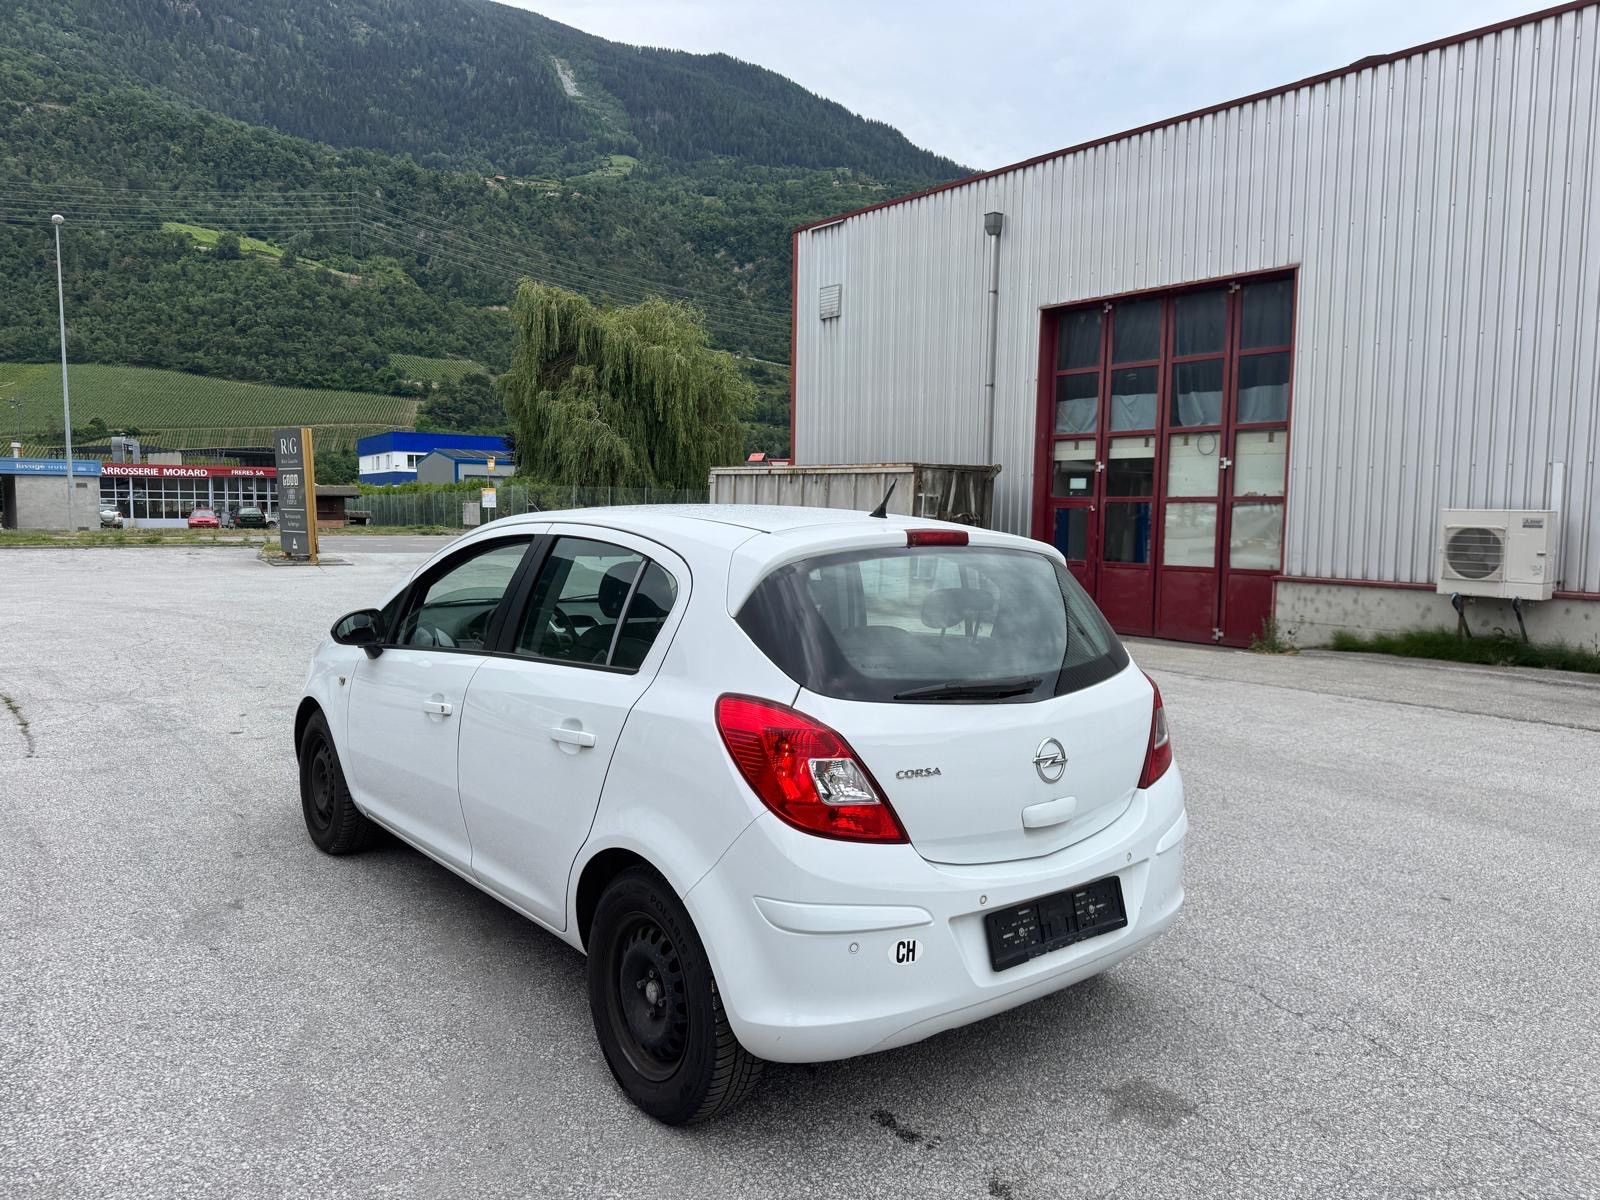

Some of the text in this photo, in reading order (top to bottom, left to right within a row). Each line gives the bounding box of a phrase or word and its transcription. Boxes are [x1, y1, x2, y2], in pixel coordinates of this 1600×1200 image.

[101, 467, 208, 477] ARROSSERIE MORARD
[896, 767, 942, 780] CORSA
[650, 893, 688, 954] POLARIS
[896, 940, 916, 963] CH
